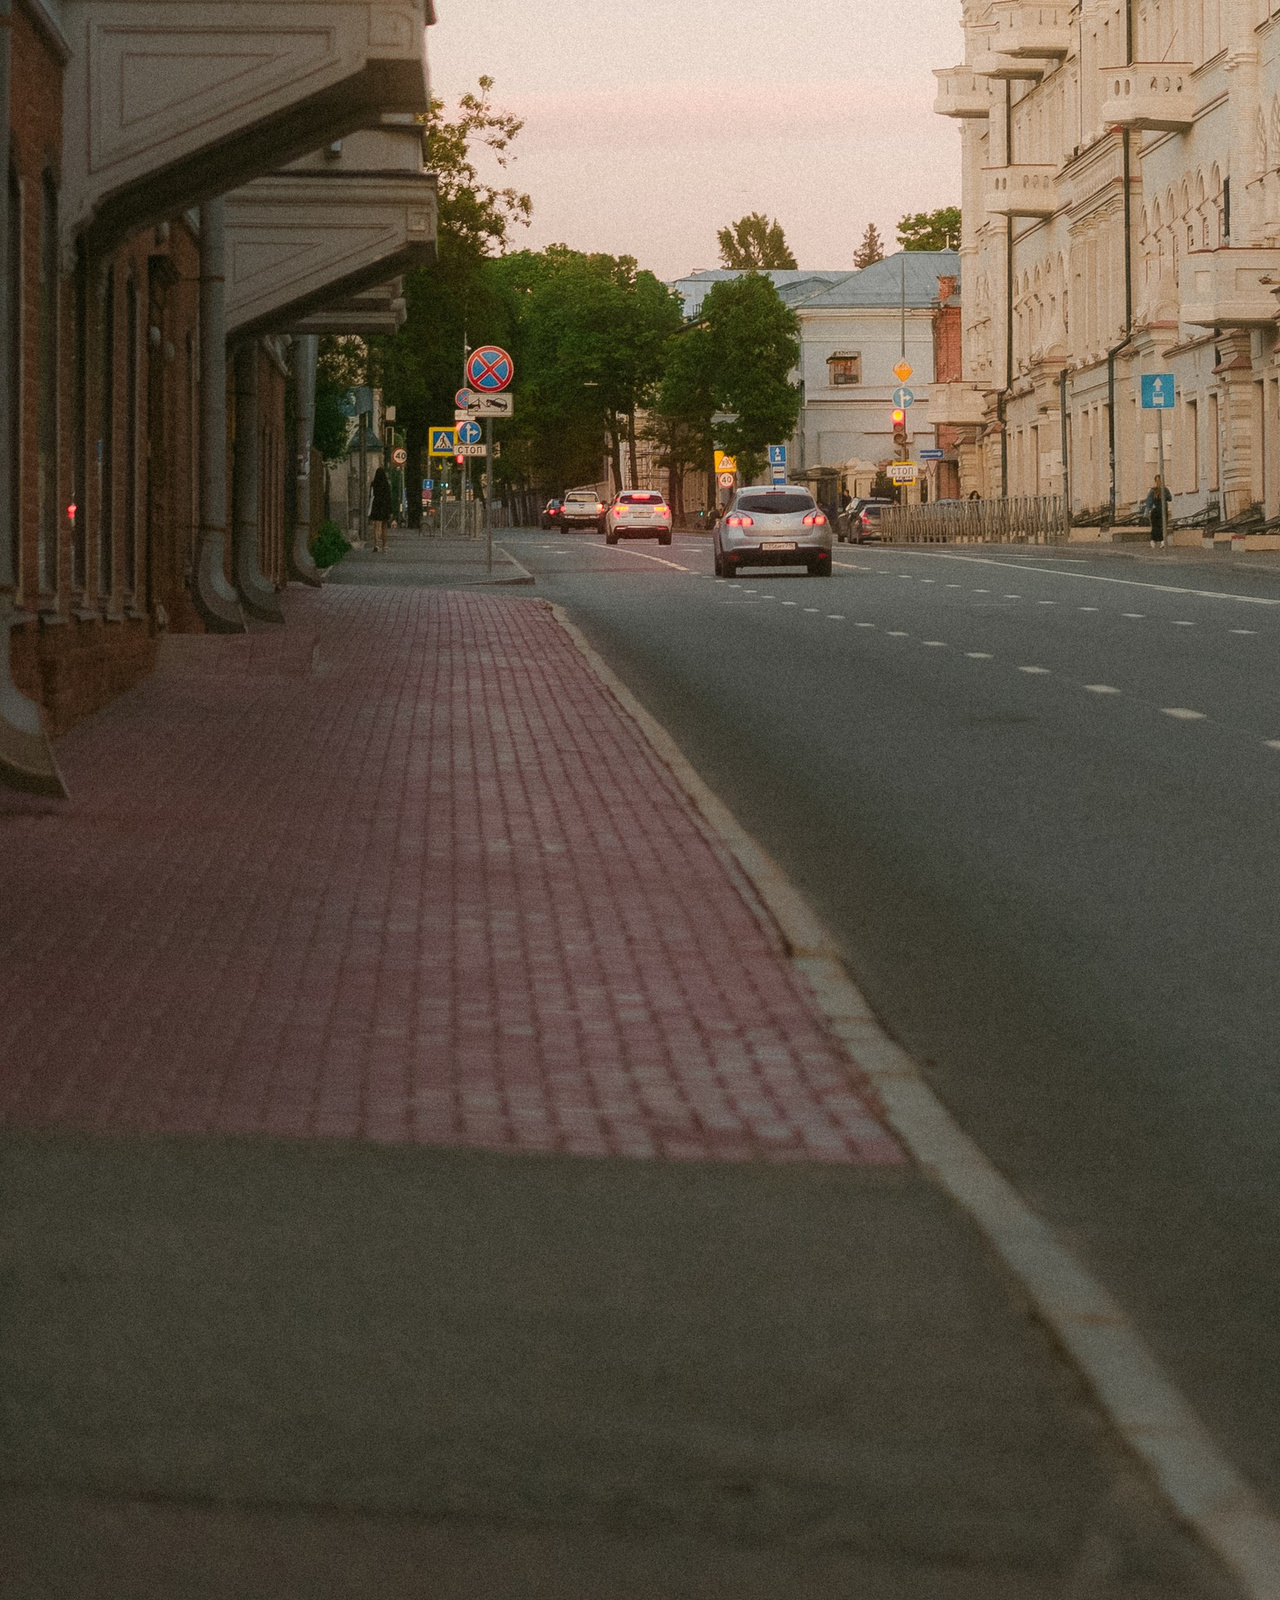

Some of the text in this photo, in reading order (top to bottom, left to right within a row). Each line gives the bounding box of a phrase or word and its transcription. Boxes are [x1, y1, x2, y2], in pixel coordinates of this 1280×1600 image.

[457, 446, 483, 454] СТОП
[395, 452, 407, 460] 40
[891, 467, 914, 475] СТОП
[721, 476, 732, 484] 40
